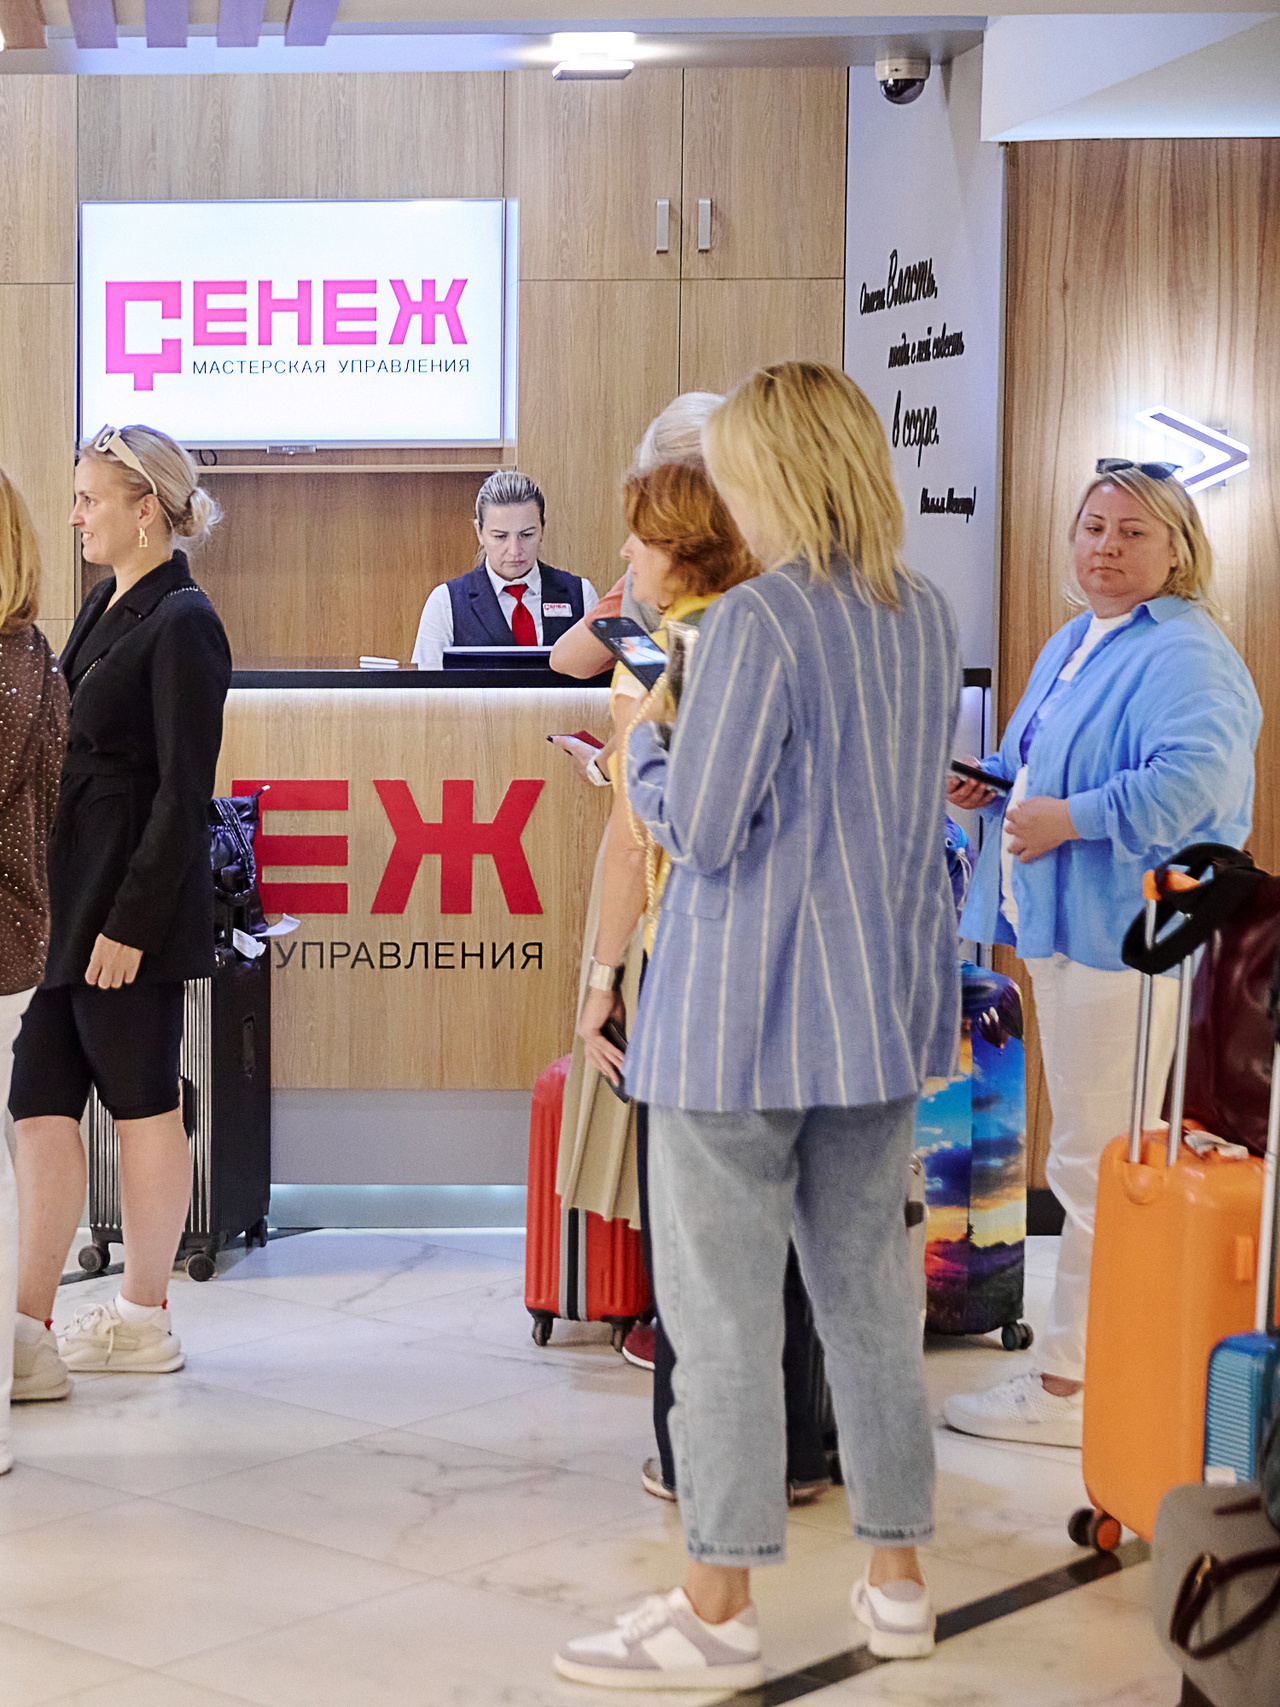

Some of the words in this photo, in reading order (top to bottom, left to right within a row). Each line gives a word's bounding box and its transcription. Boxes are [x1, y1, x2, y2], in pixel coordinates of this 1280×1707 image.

[105, 278, 468, 391] СЕНЕЖ
[192, 360, 326, 374] МАСТЕРСКАЯ
[338, 358, 470, 373] УПРАВЛЕНИЯ
[274, 940, 544, 970] УПРАВЛЕНИЯ
